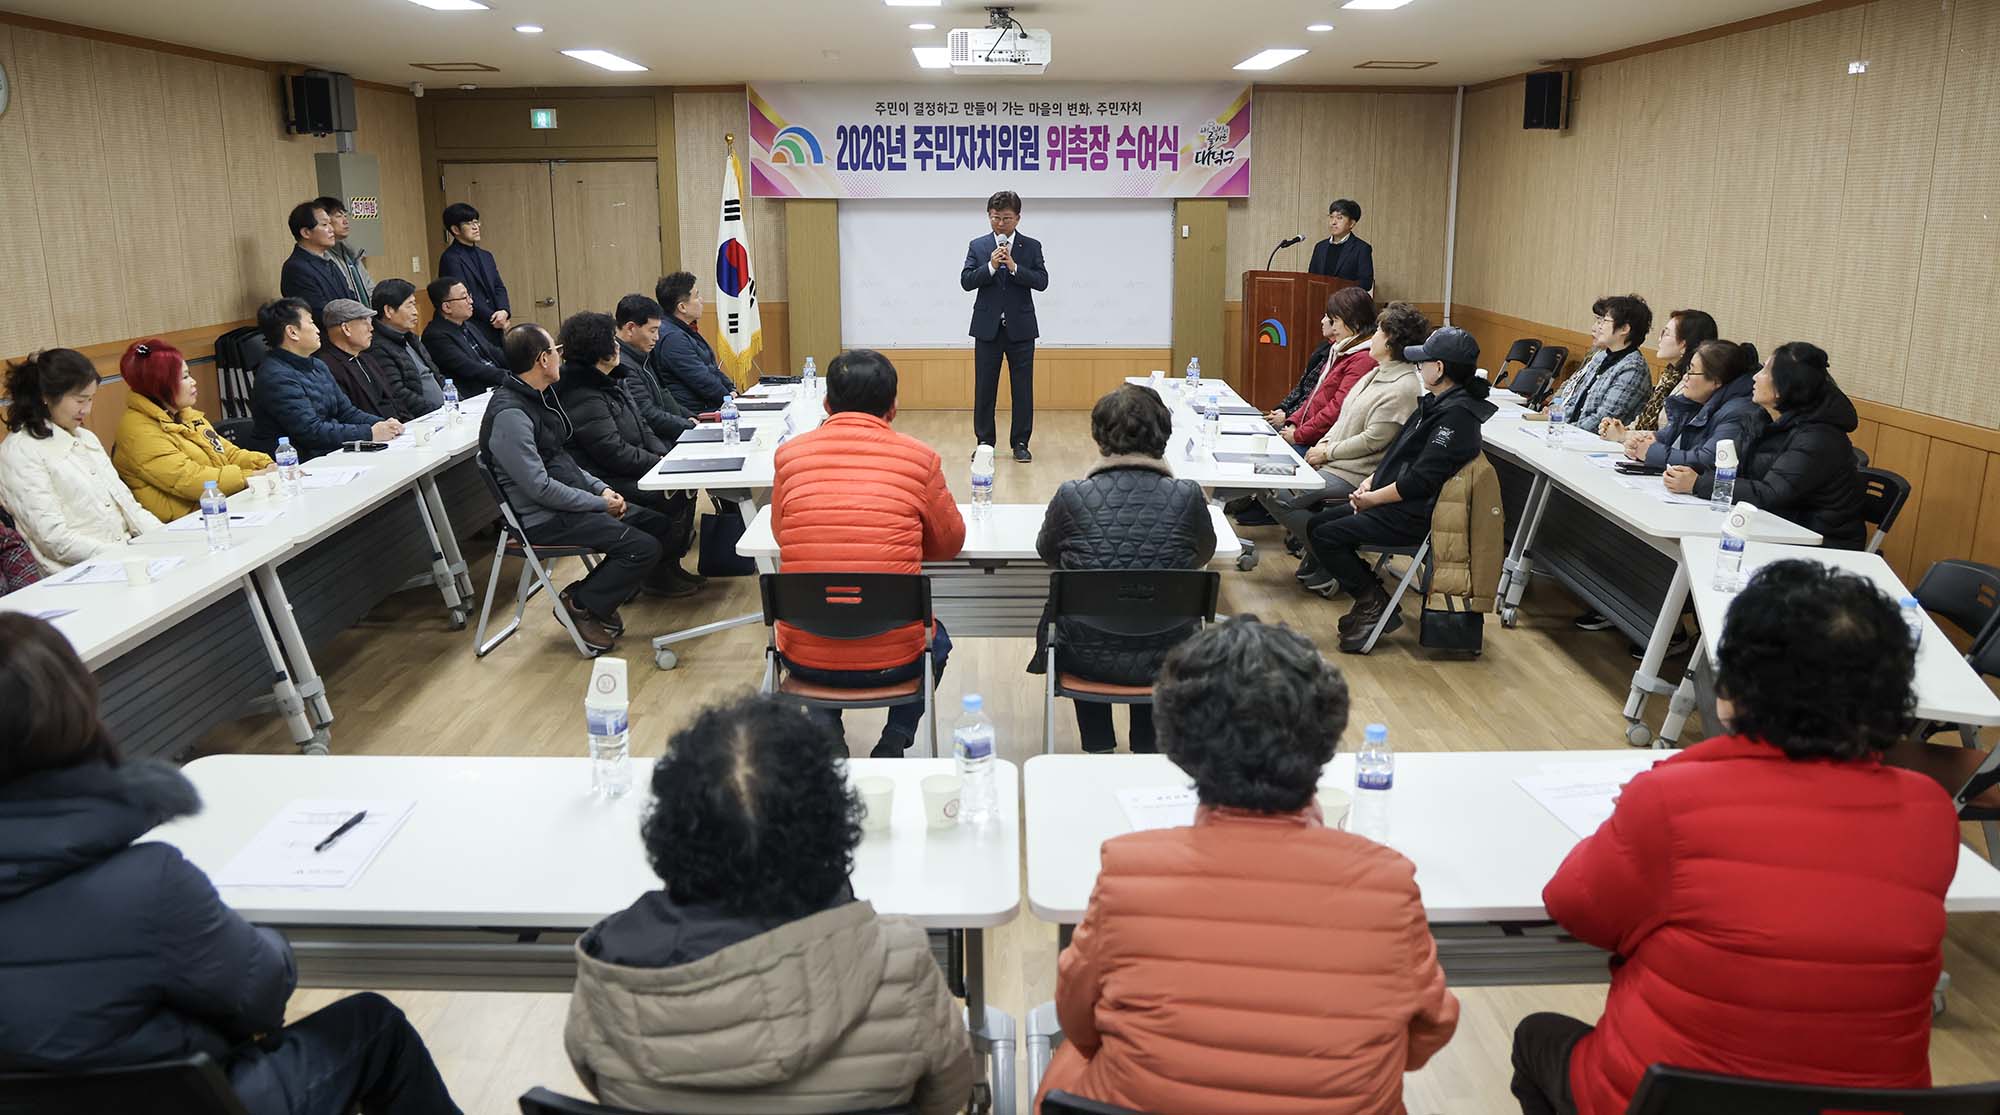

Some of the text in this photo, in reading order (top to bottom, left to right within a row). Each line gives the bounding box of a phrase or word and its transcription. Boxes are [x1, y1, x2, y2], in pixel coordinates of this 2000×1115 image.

[874, 101, 909, 116] 주민이
[914, 101, 959, 116] 결정하고
[963, 101, 997, 116] 만들어
[1002, 101, 1025, 116] 가는
[1029, 101, 1062, 117] 마을의
[1096, 101, 1142, 116] 주민자치
[836, 124, 1179, 172] 2026년 주민자치위원 위촉장 수여식
[1194, 149, 1235, 166] 대덕구
